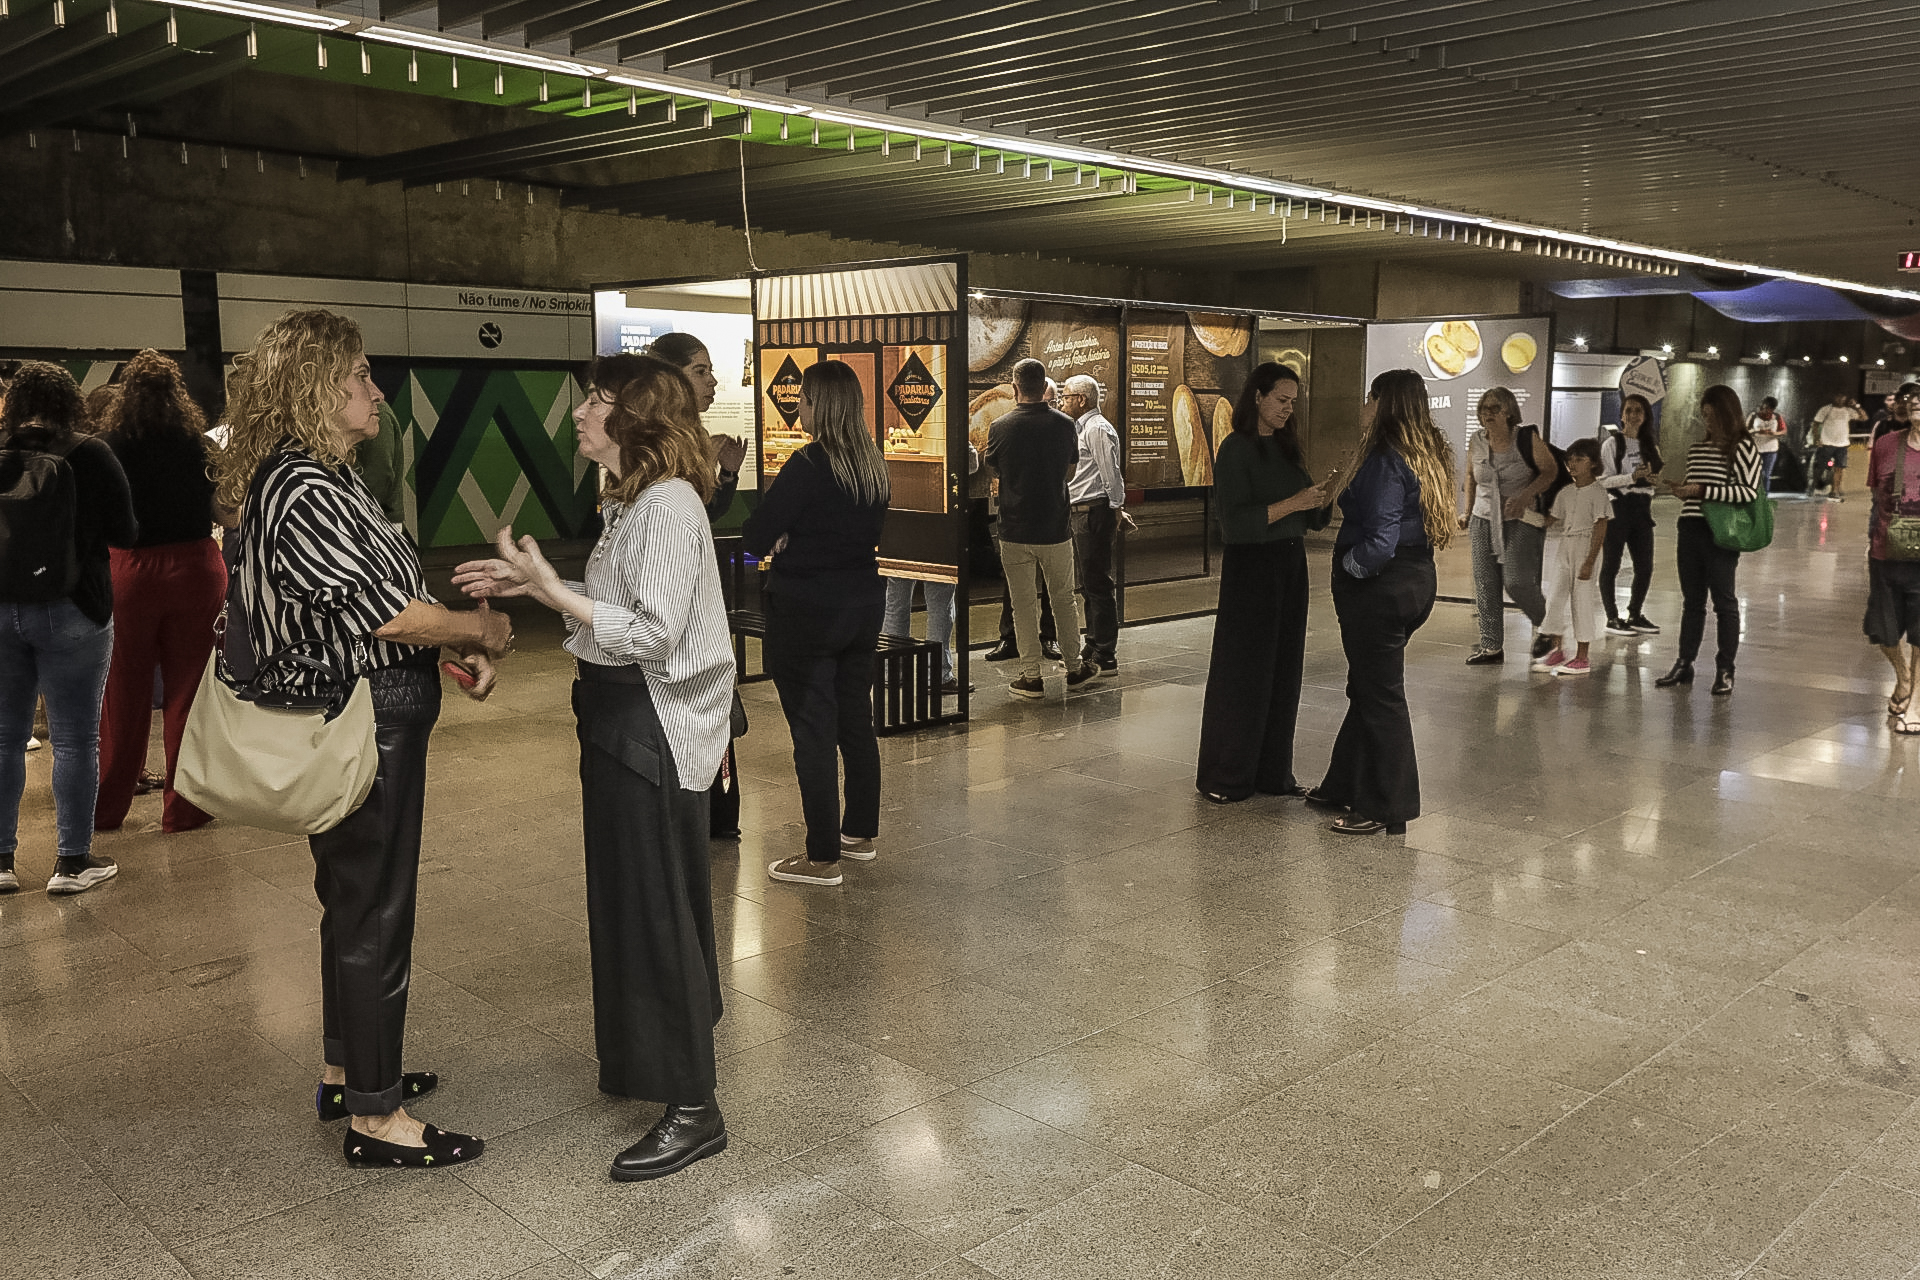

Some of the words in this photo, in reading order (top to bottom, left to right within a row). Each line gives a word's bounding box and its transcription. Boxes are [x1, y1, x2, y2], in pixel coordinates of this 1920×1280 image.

[458, 292, 484, 306] Não
[488, 294, 519, 308] fume
[522, 296, 529, 308] /
[529, 297, 546, 310] No
[1044, 339, 1064, 354] Antes
[1064, 337, 1073, 350] da
[1051, 356, 1065, 373] pão
[1061, 353, 1072, 370] já
[1087, 348, 1110, 362] história
[894, 384, 936, 396] PADARIAS
[1144, 399, 1154, 410] 70
[1130, 424, 1145, 435] 29,3
[1144, 424, 1153, 436] kg
